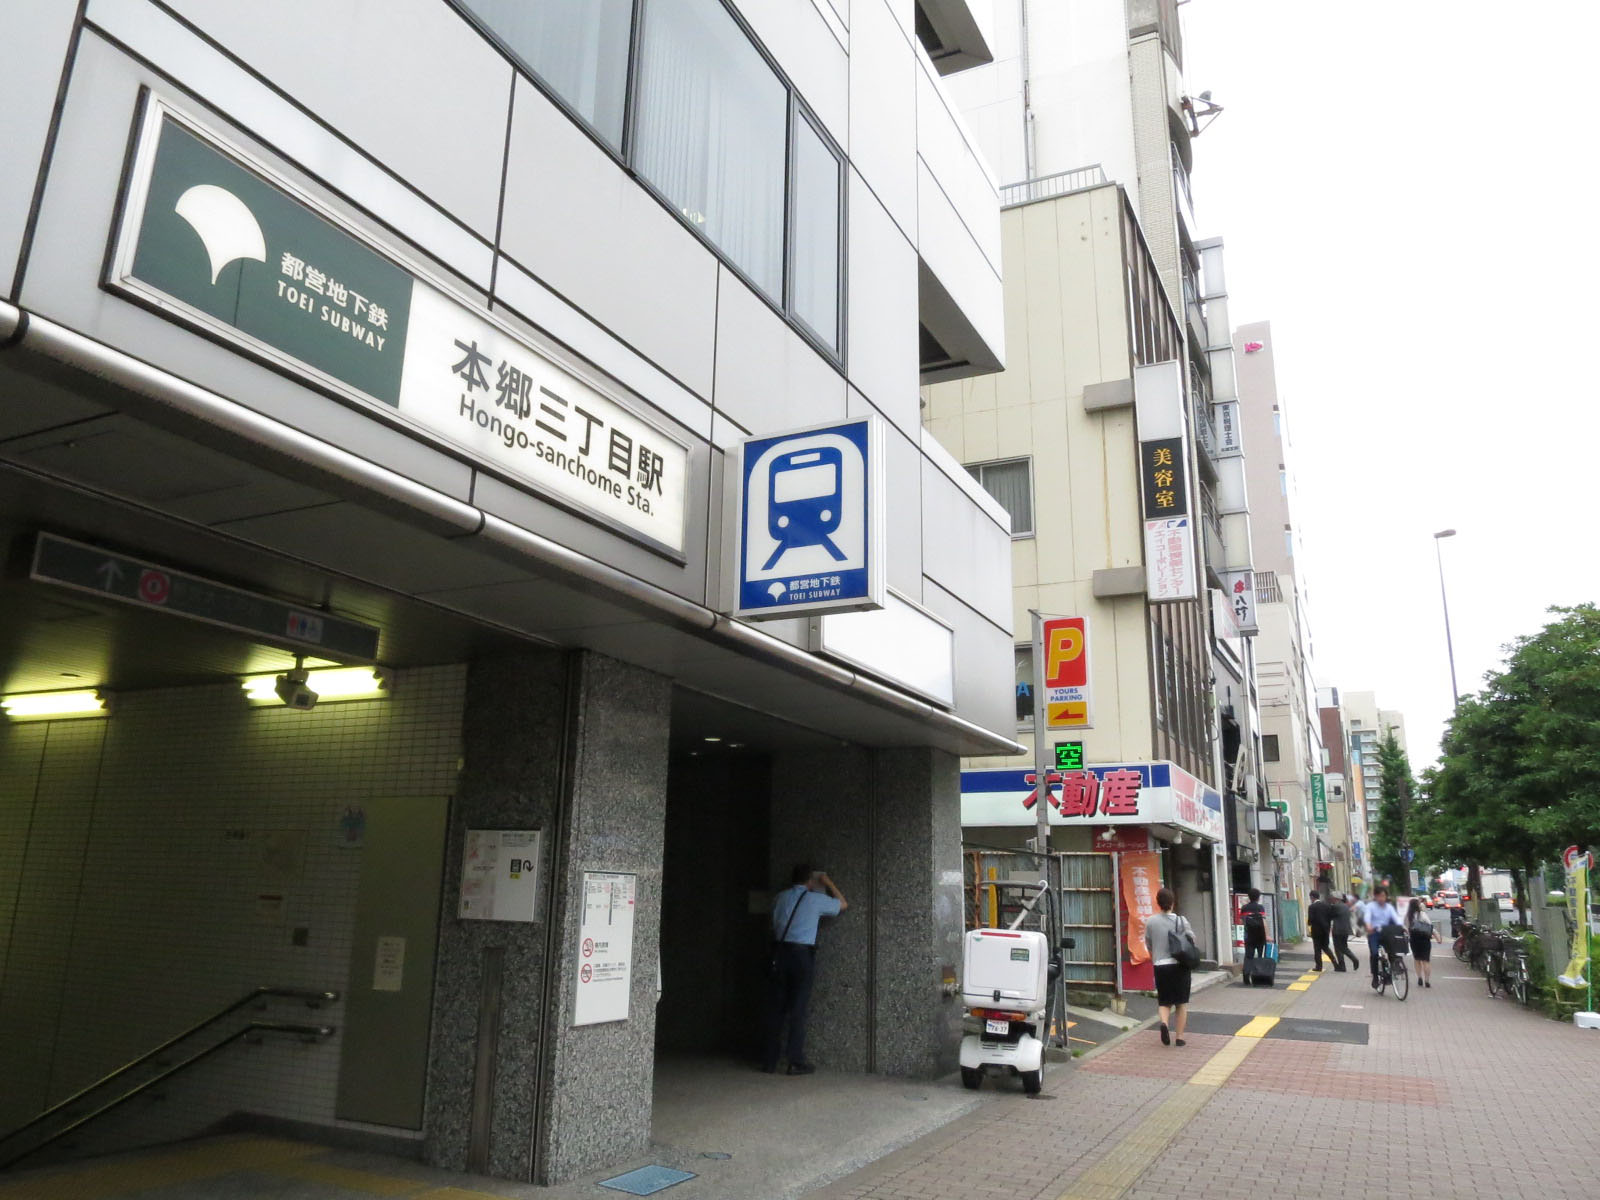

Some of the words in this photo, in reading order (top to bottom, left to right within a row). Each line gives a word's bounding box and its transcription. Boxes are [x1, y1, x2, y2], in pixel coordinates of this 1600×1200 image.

[278, 280, 314, 313] TOEI
[320, 305, 385, 351] SUBWAY
[281, 252, 388, 331] 都営地下鉄
[451, 338, 664, 496] 本郷三丁目駅
[459, 393, 622, 499] Hongo-sanchome
[627, 486, 654, 516] Sta.
[1153, 448, 1175, 508] 美容室
[789, 576, 840, 591] 都営地下鉄
[809, 588, 840, 599] SUBWAY
[1046, 627, 1083, 679] P
[1050, 694, 1083, 702] PARKING
[1054, 687, 1078, 695] YOURS
[1056, 743, 1083, 769] 空
[1023, 769, 1143, 818] 不動産
